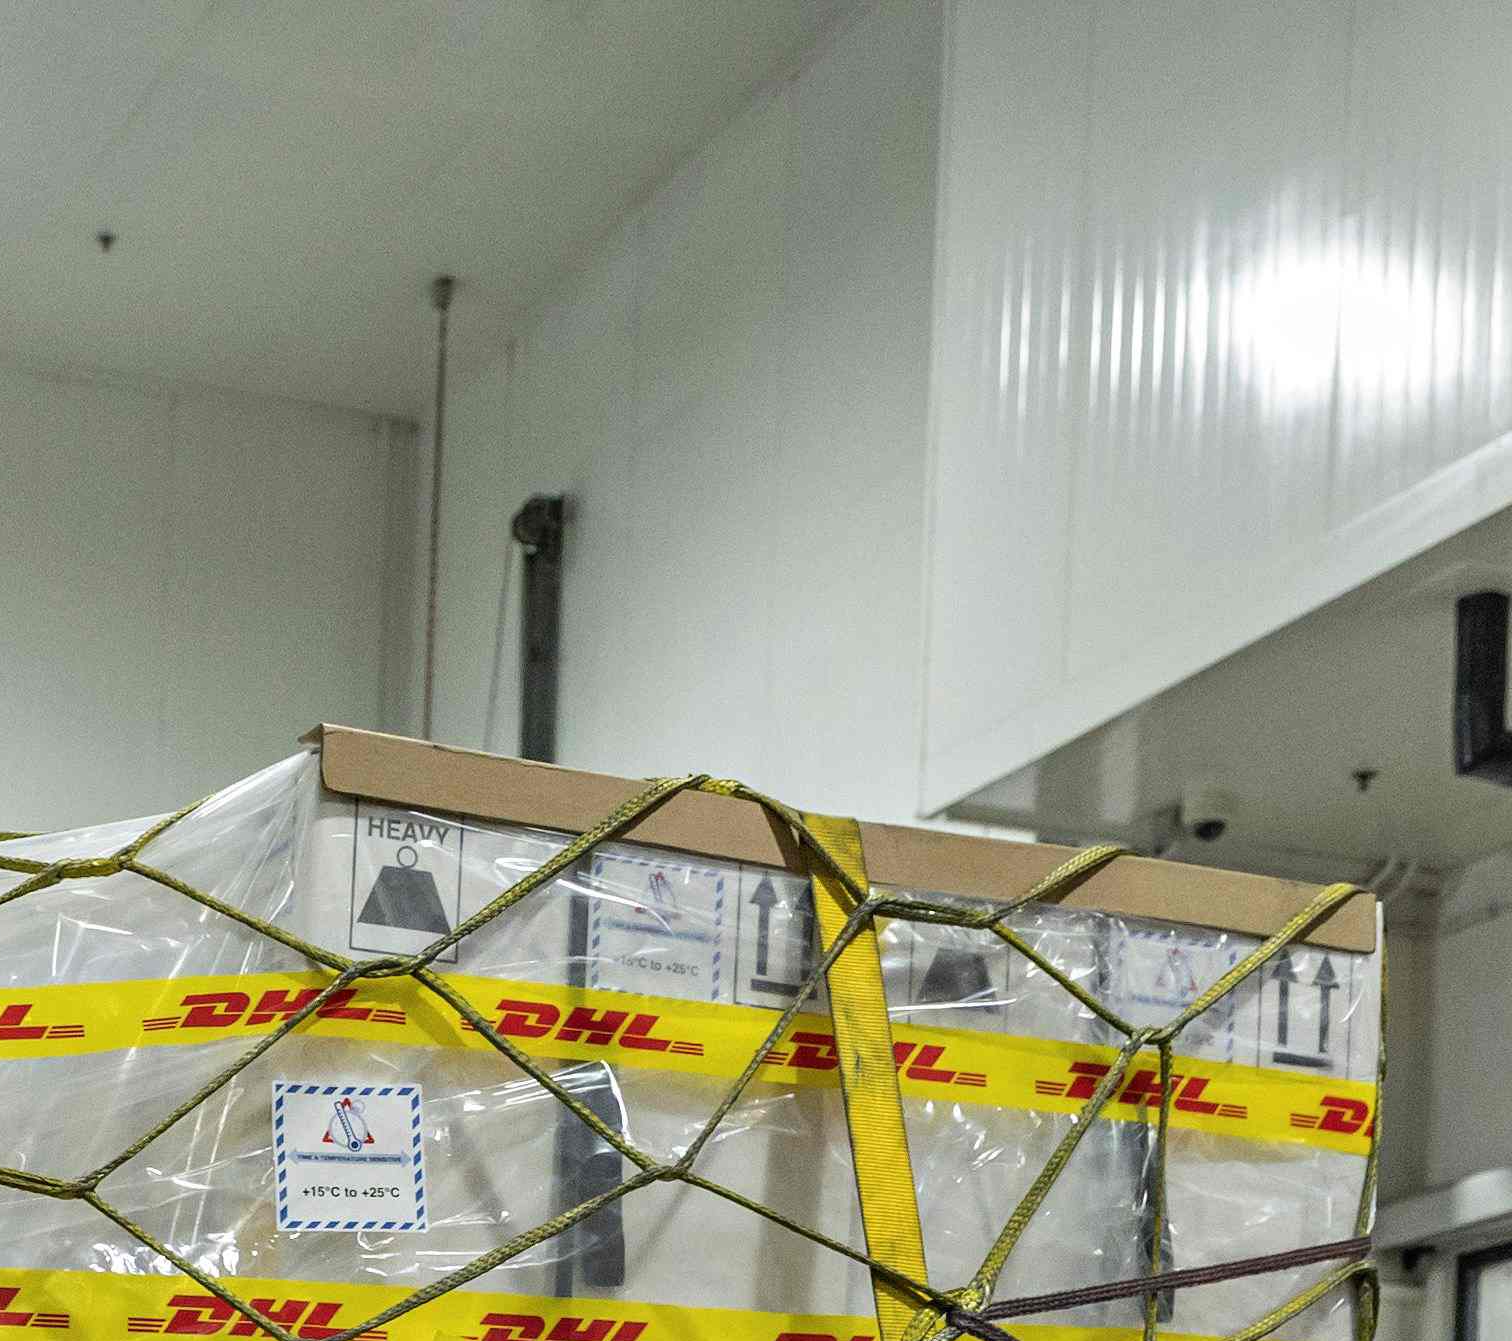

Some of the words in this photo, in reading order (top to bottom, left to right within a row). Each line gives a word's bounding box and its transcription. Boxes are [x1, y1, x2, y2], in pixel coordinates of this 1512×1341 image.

[368, 815, 450, 845] HEAVY
[183, 990, 369, 1026] DHL
[499, 1002, 668, 1050] DHL
[302, 1186, 340, 1198] +15°C
[344, 1187, 358, 1198] to
[361, 1187, 401, 1198] +25°C
[167, 1296, 354, 1338] DHL
